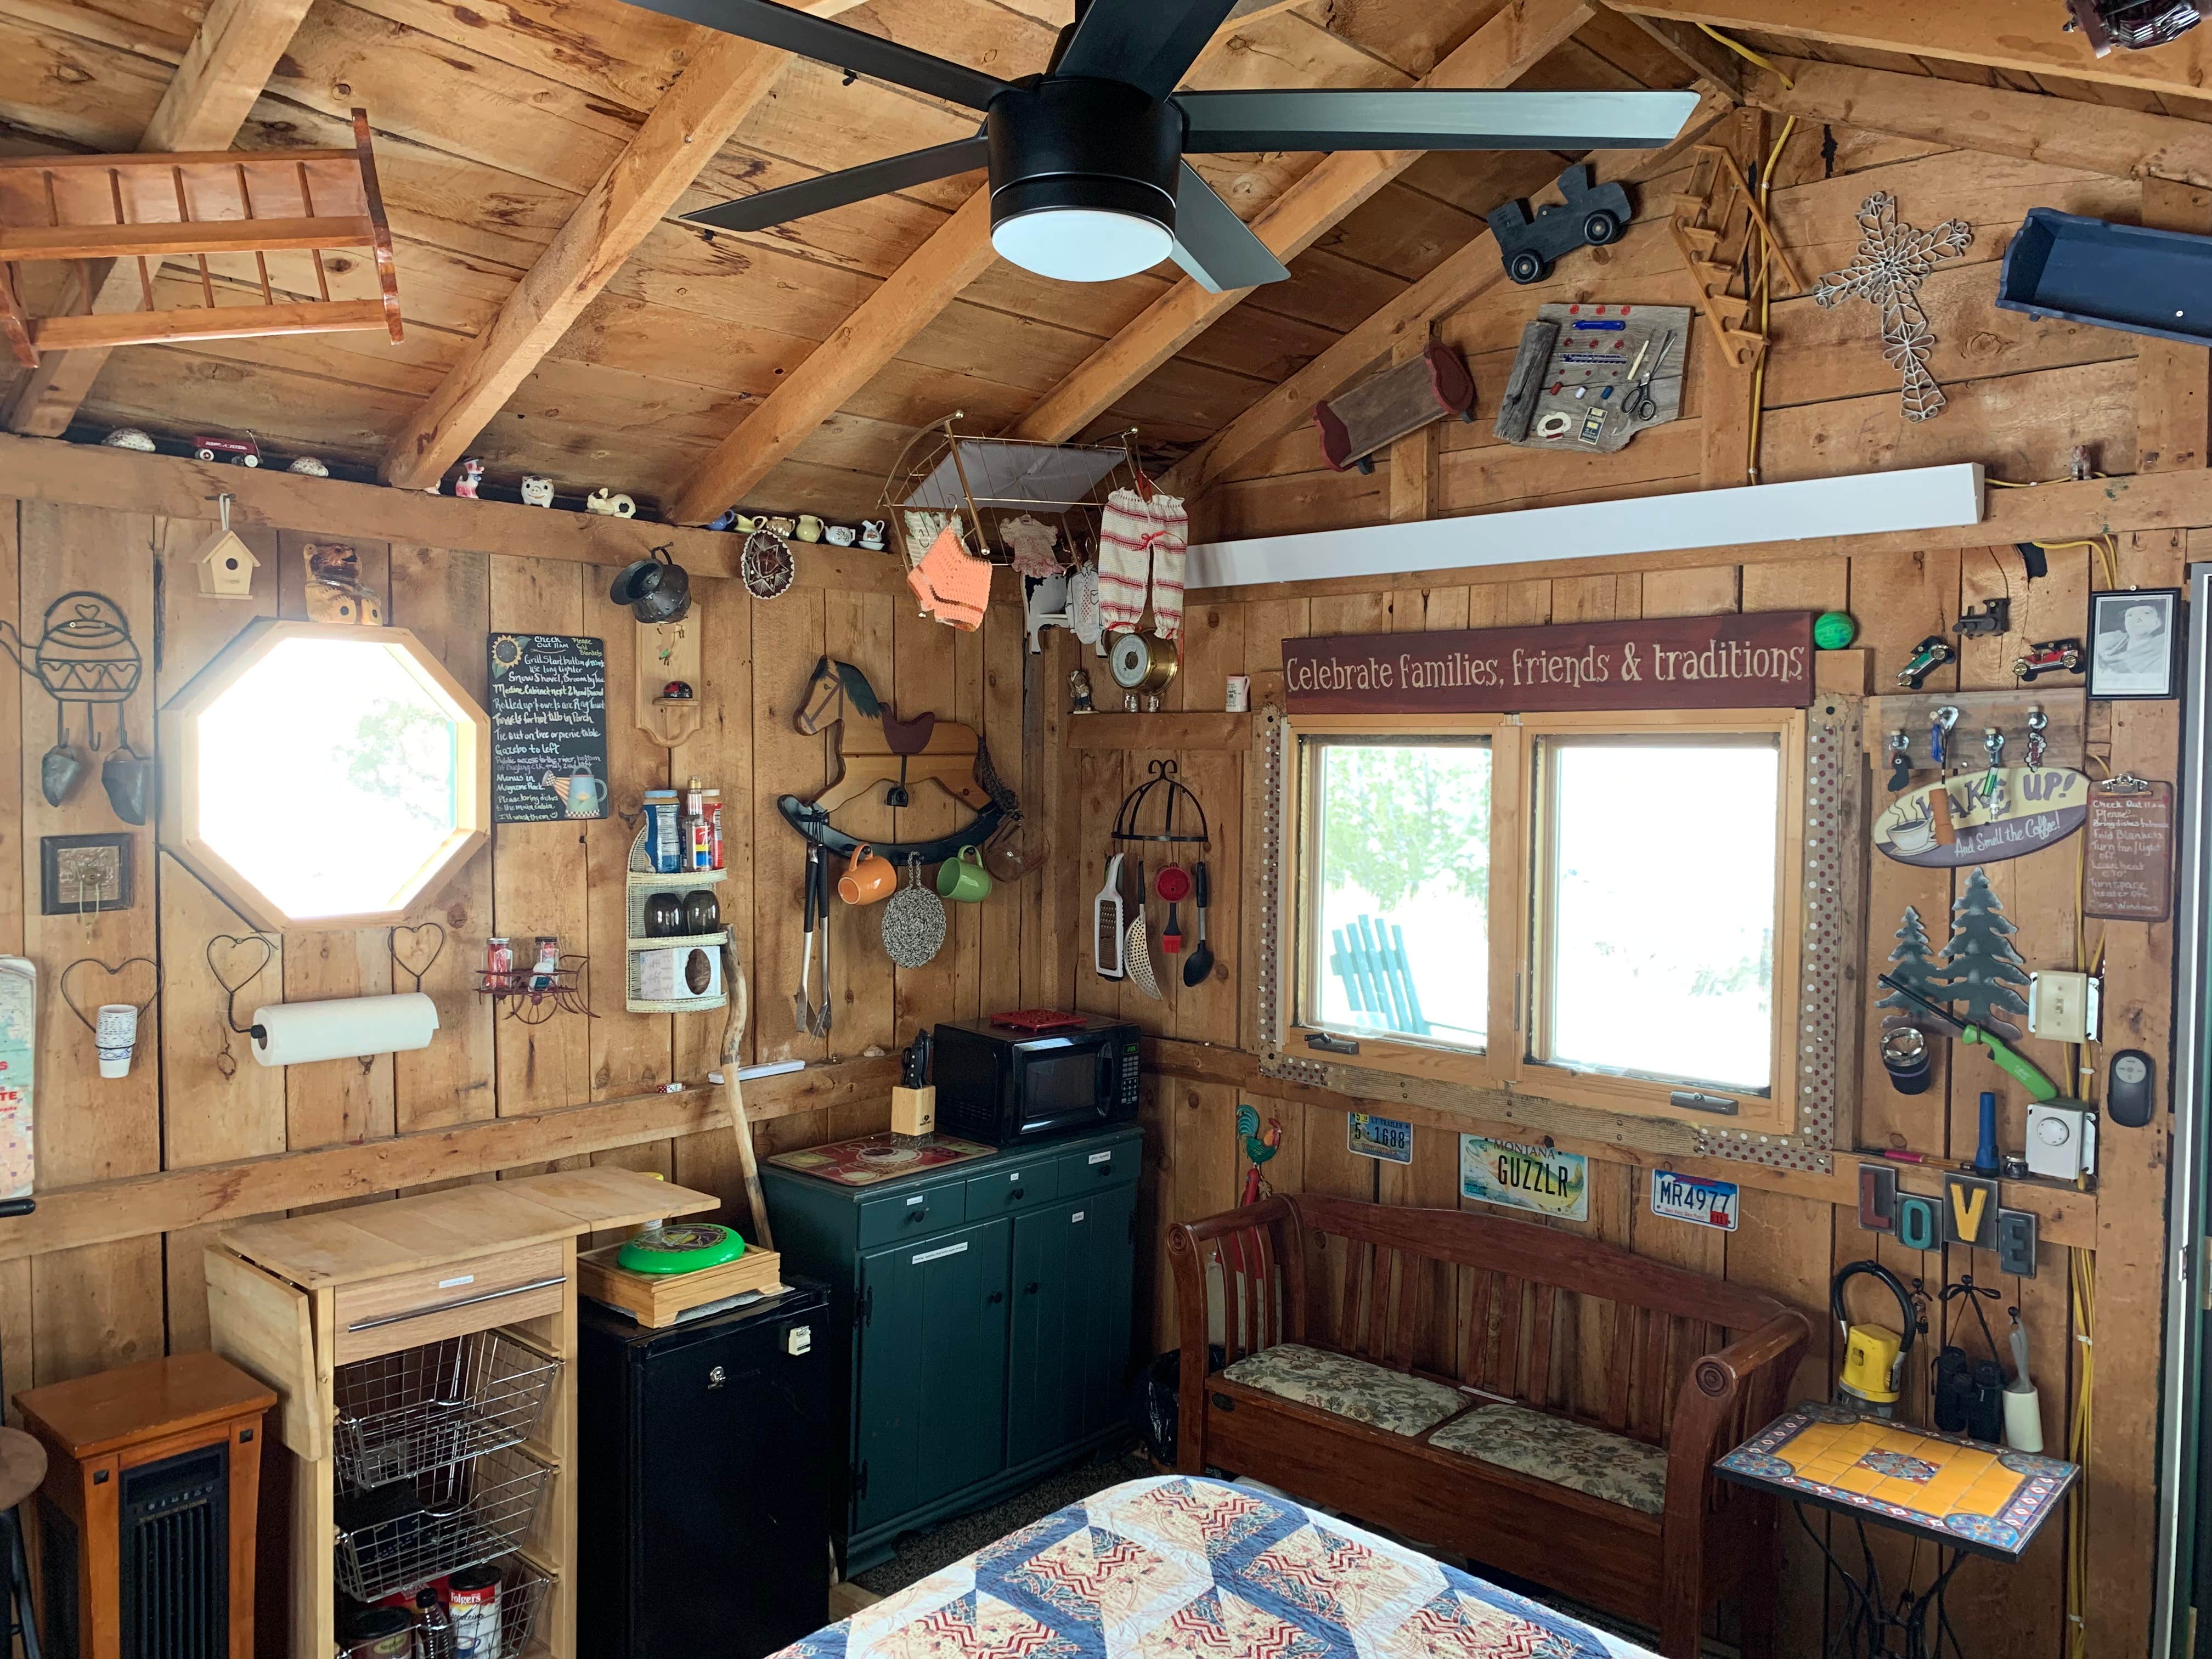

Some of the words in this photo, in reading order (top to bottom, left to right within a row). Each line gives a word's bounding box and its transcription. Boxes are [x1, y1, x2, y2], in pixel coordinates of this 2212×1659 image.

[524, 654, 543, 665] Grill
[1287, 657, 1393, 692] Celebrate
[1400, 652, 1504, 689] families,
[1512, 645, 1611, 689] friends
[1621, 641, 1643, 681] &
[508, 671, 534, 684] Snow
[586, 674, 596, 690] by
[567, 686, 574, 696] 2
[492, 697, 523, 712] Rolled
[523, 702, 534, 712] up
[523, 711, 534, 724] for
[534, 711, 548, 725] hot
[563, 712, 573, 725] in
[572, 712, 595, 724] Porch
[494, 727, 508, 741] Tie
[524, 732, 535, 741] on
[535, 727, 549, 739] tree
[550, 730, 559, 738] or
[558, 728, 580, 741] picnic
[581, 727, 601, 738] table
[495, 744, 527, 755] Gazebo
[529, 744, 541, 753] to
[541, 742, 560, 754] left
[496, 774, 524, 782] Menus
[526, 773, 535, 782] in
[2023, 771, 2077, 801] UP!
[498, 795, 521, 804] Please
[520, 793, 540, 805] bring
[2092, 799, 2124, 808] Check
[1954, 838, 1975, 857] And
[1976, 825, 2004, 851] Smell
[2004, 826, 2024, 842] the
[2025, 810, 2061, 840] Coffee!
[2094, 828, 2113, 839] Fold
[2091, 839, 2116, 851] Turn
[1380, 1119, 1403, 1129] TRAILER
[1374, 1126, 1405, 1149] 1688
[1493, 1139, 1555, 1160] MONTANA
[1498, 1155, 1568, 1199] GUZZLR
[1661, 1181, 1730, 1213] MR4977
[450, 1592, 481, 1605] Folgers
